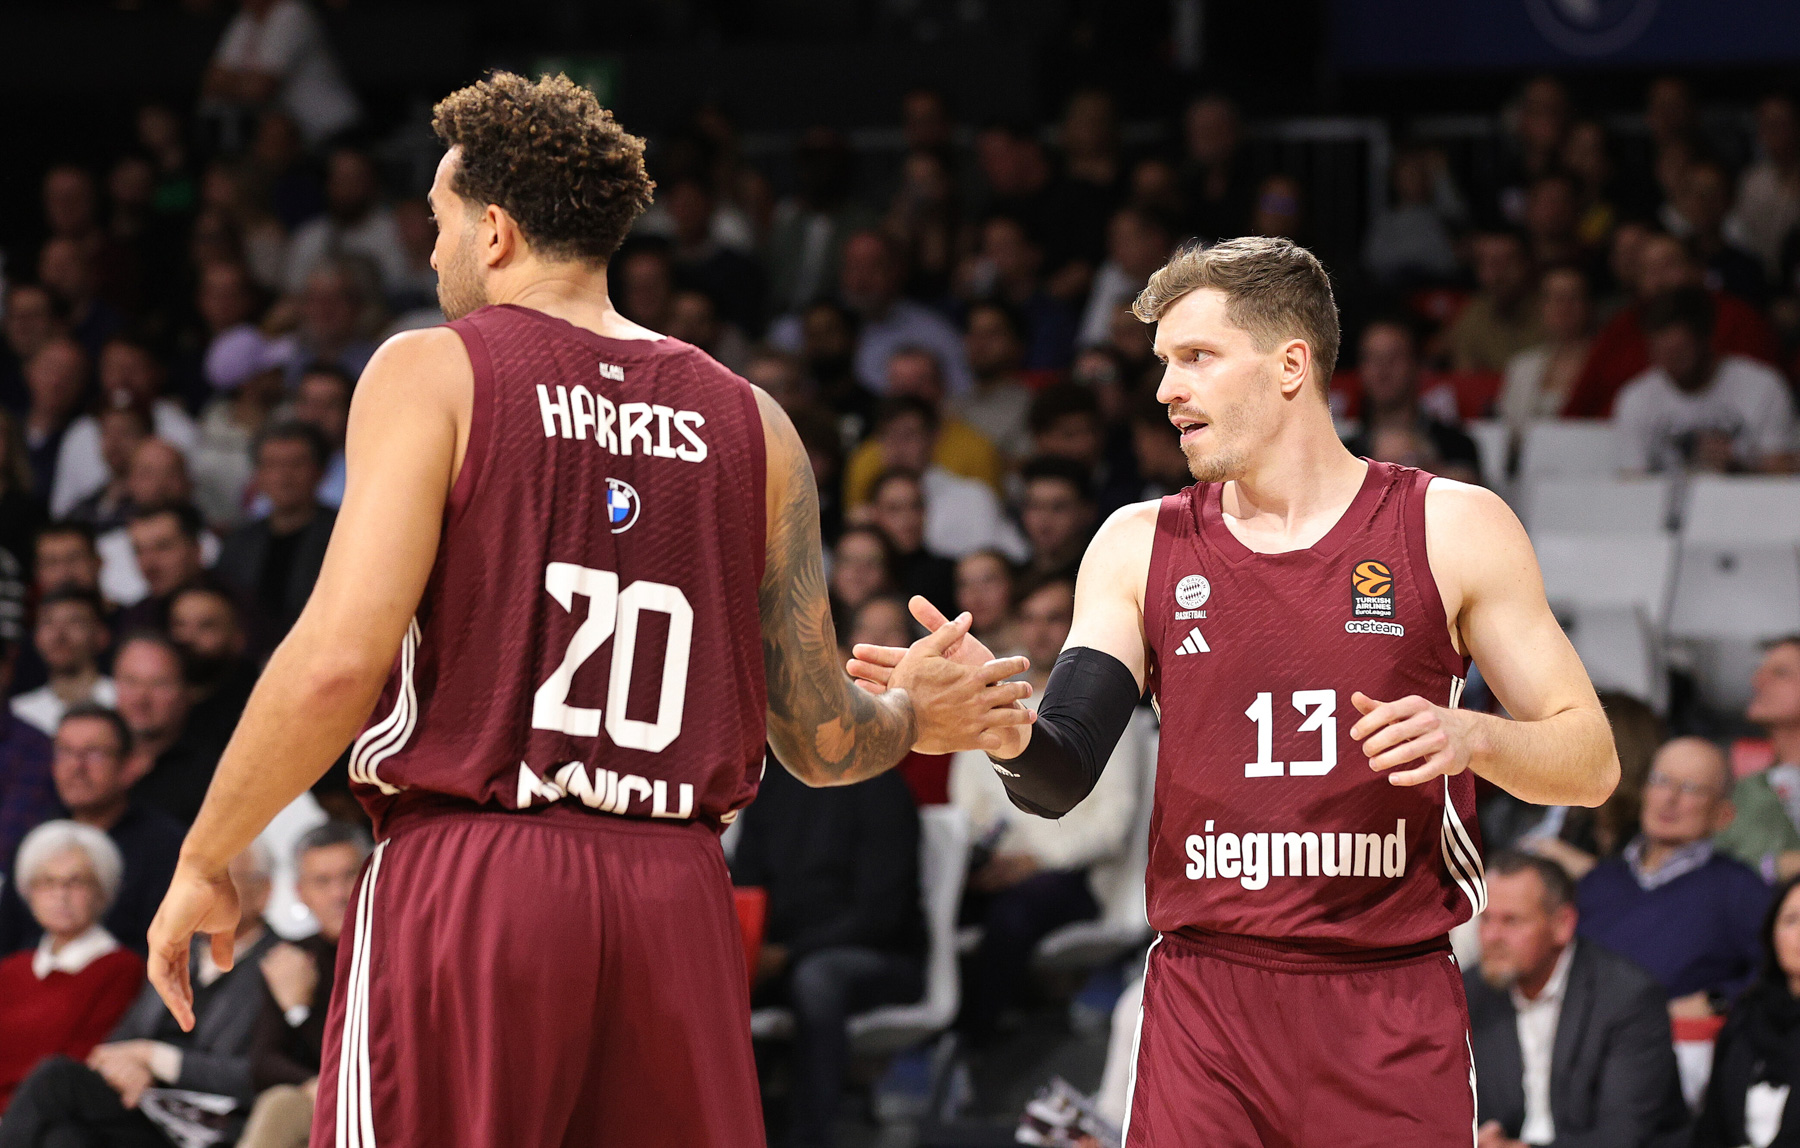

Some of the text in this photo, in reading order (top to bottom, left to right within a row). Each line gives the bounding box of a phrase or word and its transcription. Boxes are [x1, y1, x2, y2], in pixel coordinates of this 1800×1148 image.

[536, 384, 707, 463] HARRIS
[1175, 610, 1207, 620] BASKETBALL
[532, 562, 694, 753] 20
[1244, 689, 1337, 778] 13
[517, 760, 694, 819] MNICH
[1185, 818, 1406, 890] siegmund
